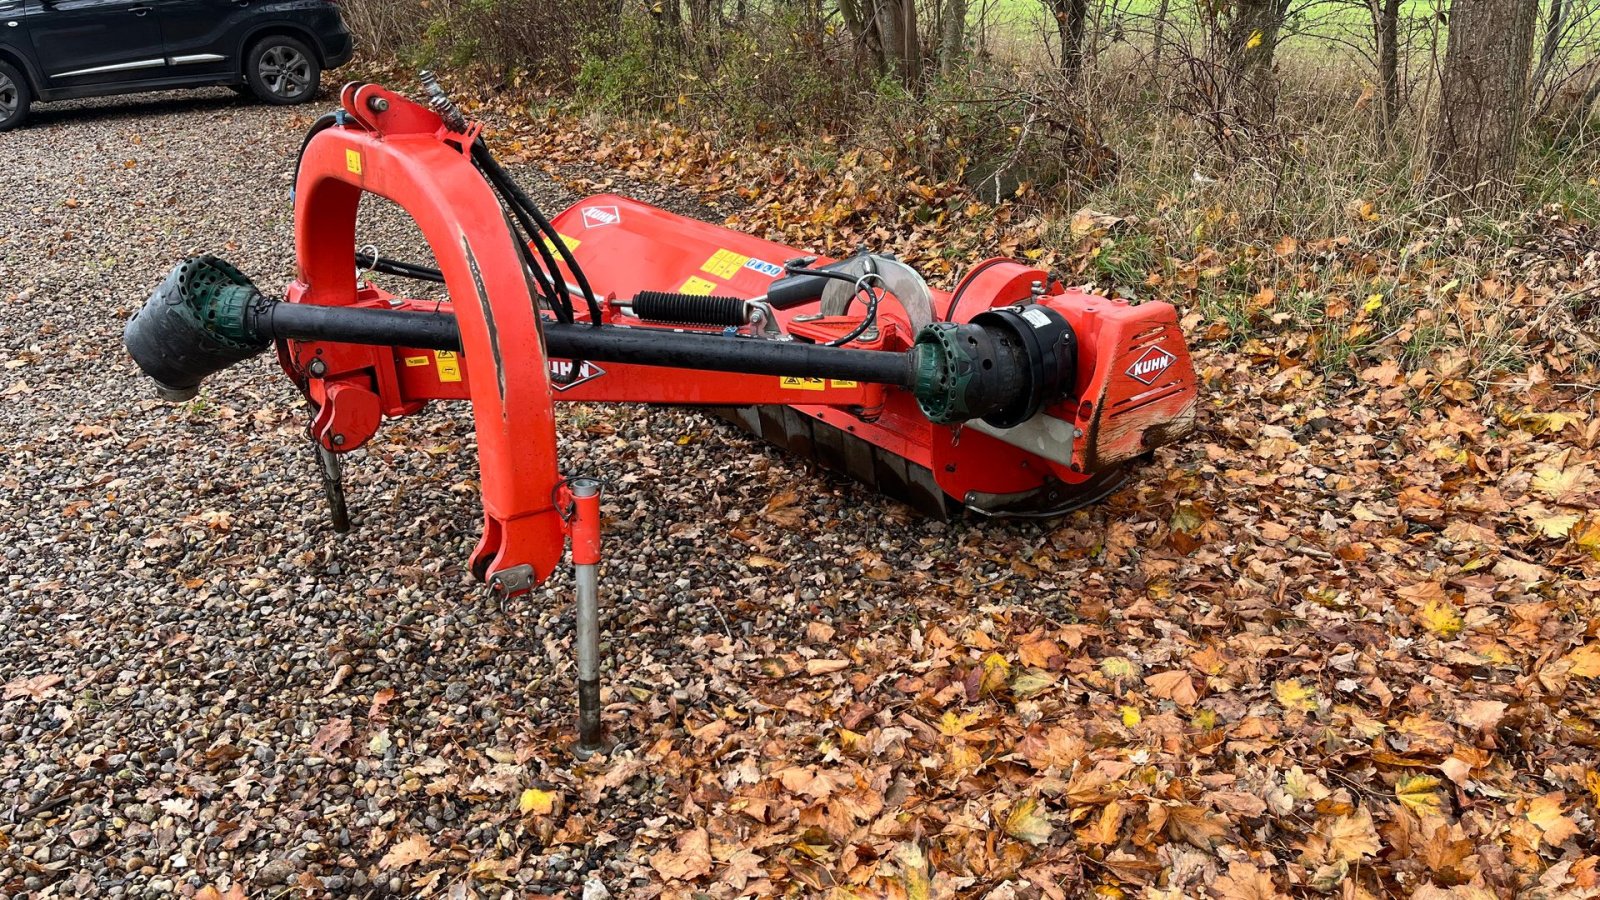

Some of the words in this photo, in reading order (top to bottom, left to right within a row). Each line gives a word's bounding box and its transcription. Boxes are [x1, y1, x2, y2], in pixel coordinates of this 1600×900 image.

[584, 207, 617, 223] KUHN
[548, 361, 589, 378] UHN
[1134, 354, 1169, 376] KUHN
